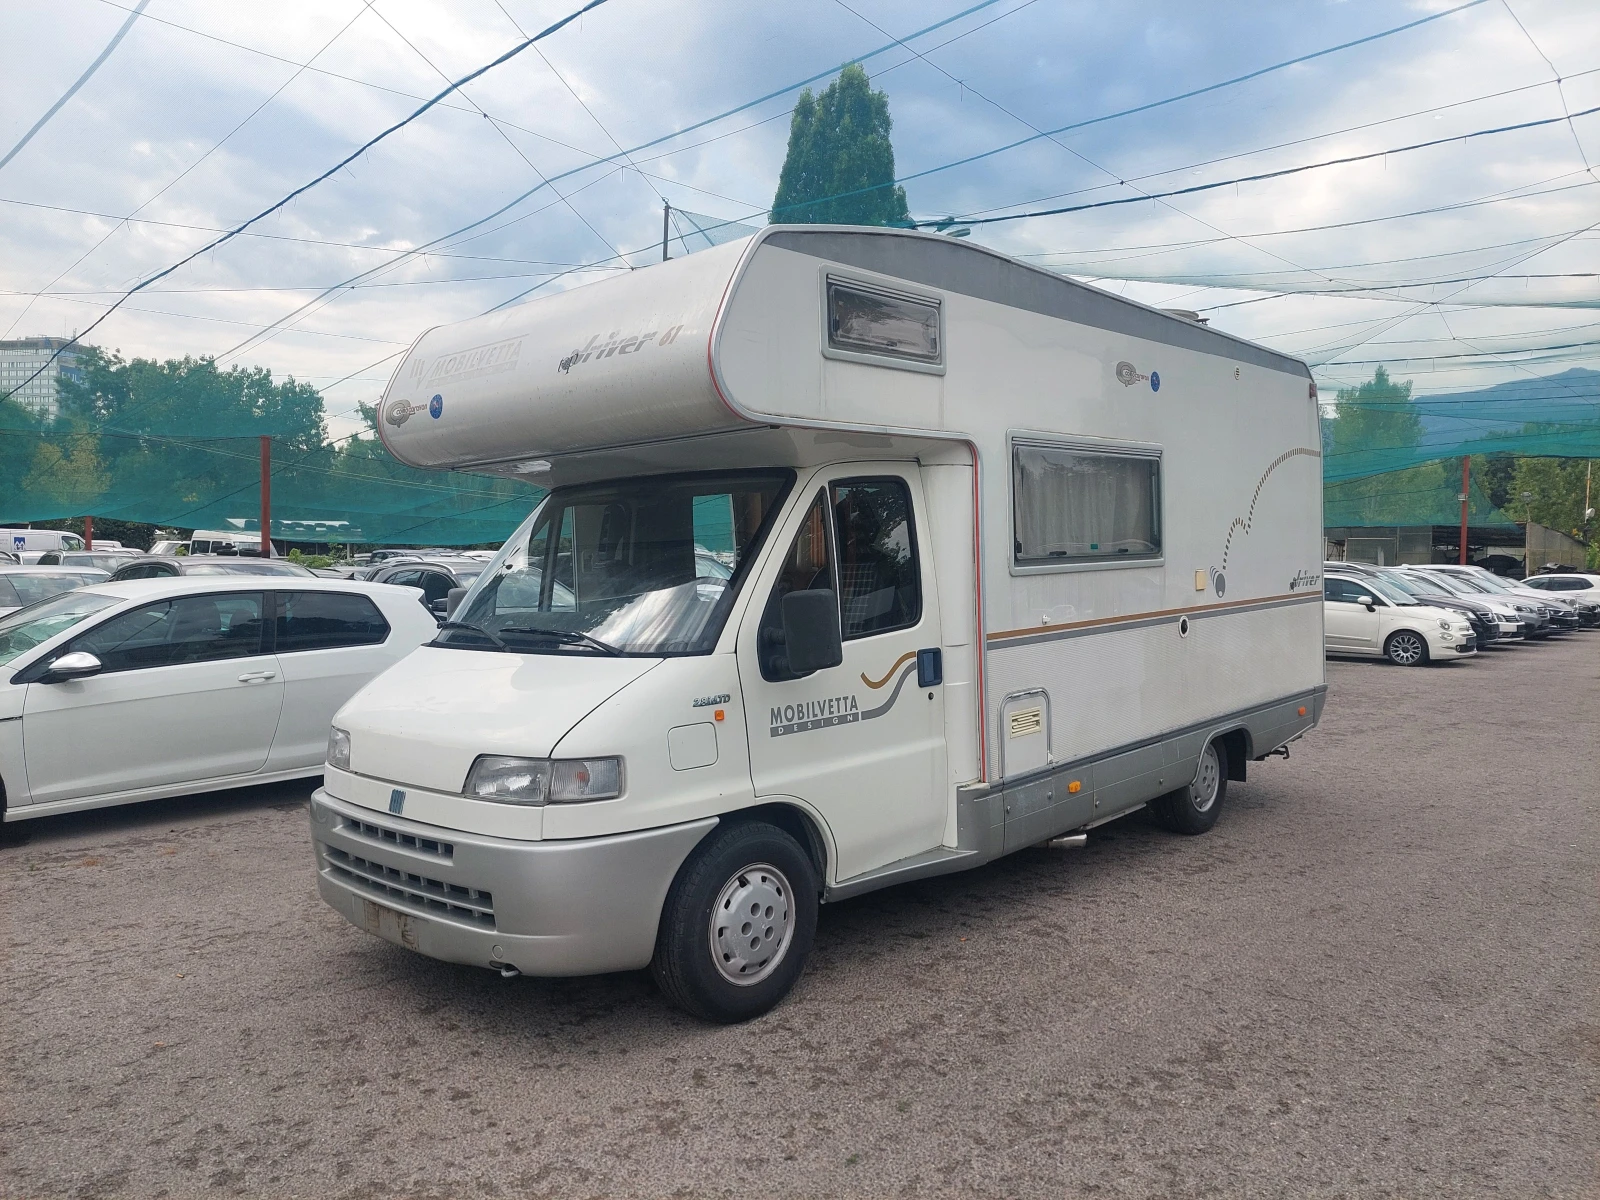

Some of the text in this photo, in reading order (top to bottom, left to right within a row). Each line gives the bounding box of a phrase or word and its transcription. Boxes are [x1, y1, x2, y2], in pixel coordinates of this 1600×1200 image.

[429, 340, 523, 379] MOBILVETTA
[569, 324, 684, 365] driver 61
[770, 694, 858, 726] MOBILVETTA
[778, 714, 853, 735] DESIGN
